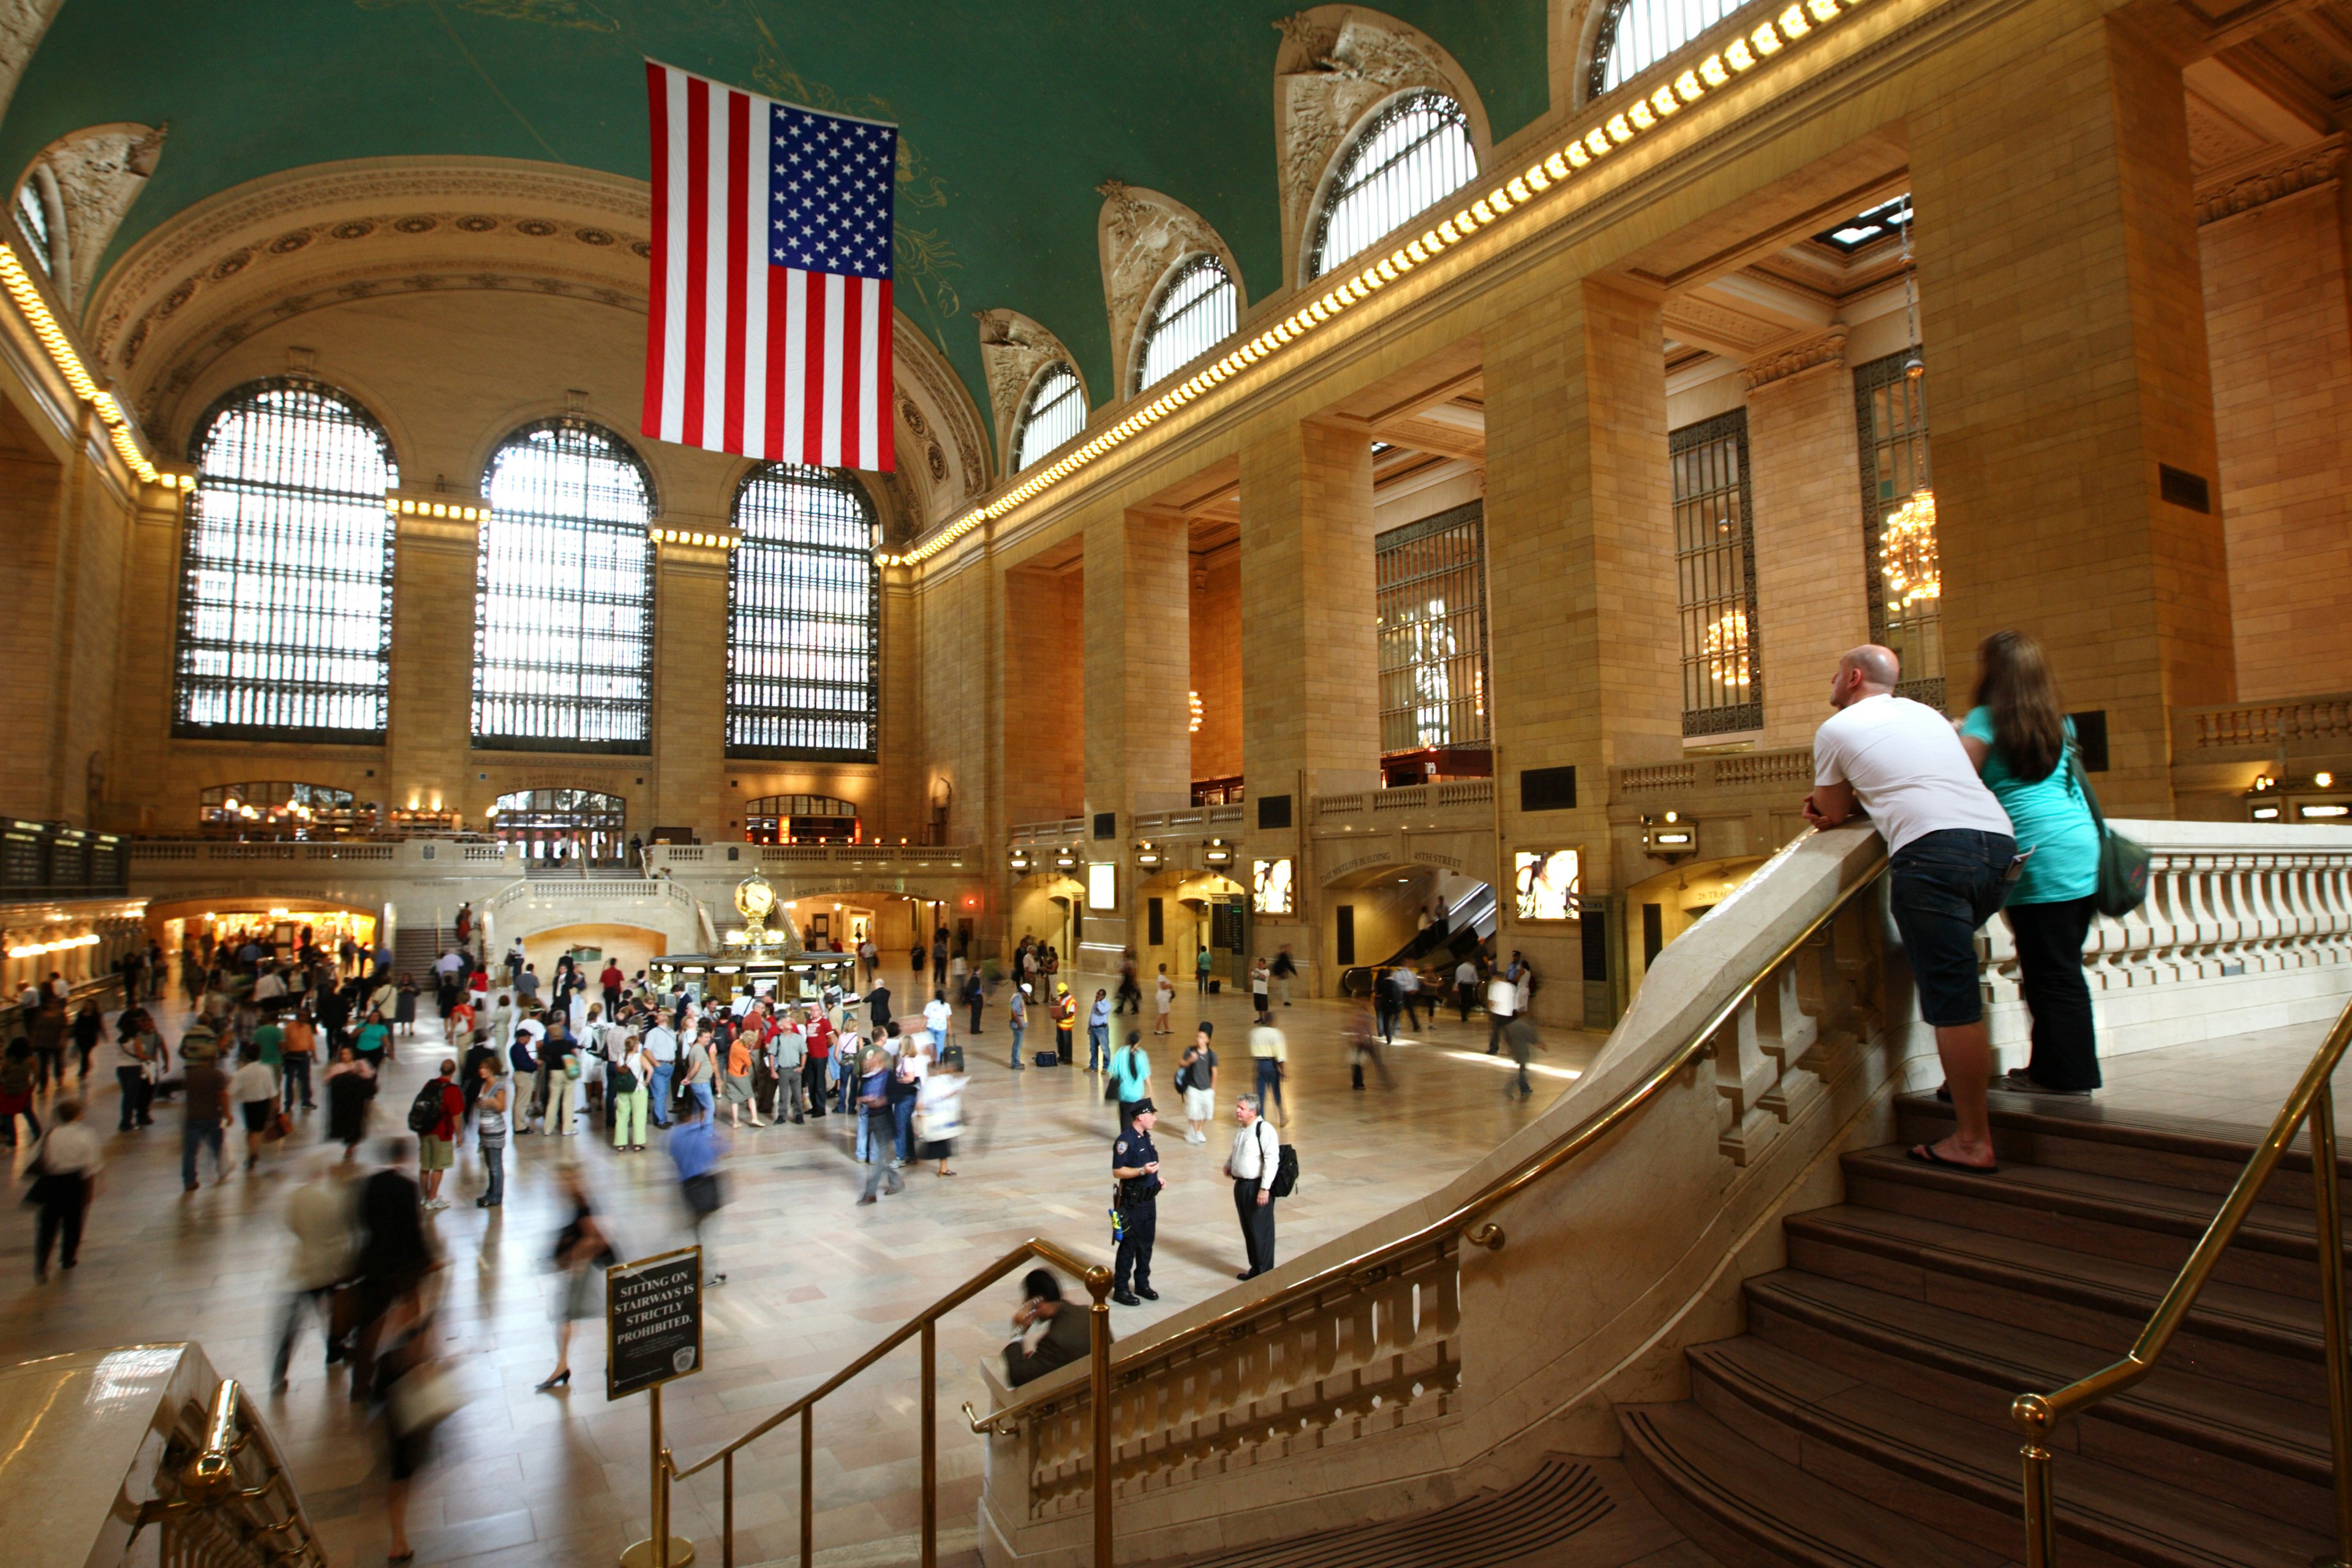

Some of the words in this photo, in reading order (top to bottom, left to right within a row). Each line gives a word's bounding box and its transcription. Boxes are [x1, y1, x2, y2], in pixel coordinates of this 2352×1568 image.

[1320, 871, 1332, 883] THE
[1332, 859, 1359, 875] METLIFE
[1359, 852, 1391, 865] BUILDING
[1414, 852, 1432, 862] 45TH
[1433, 854, 1463, 868] STREET
[1698, 892, 1706, 900] 26
[620, 1275, 669, 1298] SITTING
[671, 1271, 688, 1284] ON
[614, 1288, 681, 1315] STAIRWAYS
[684, 1284, 694, 1295] IS
[626, 1301, 684, 1327] STRICTLY
[617, 1314, 693, 1344] PROHIBITED.
